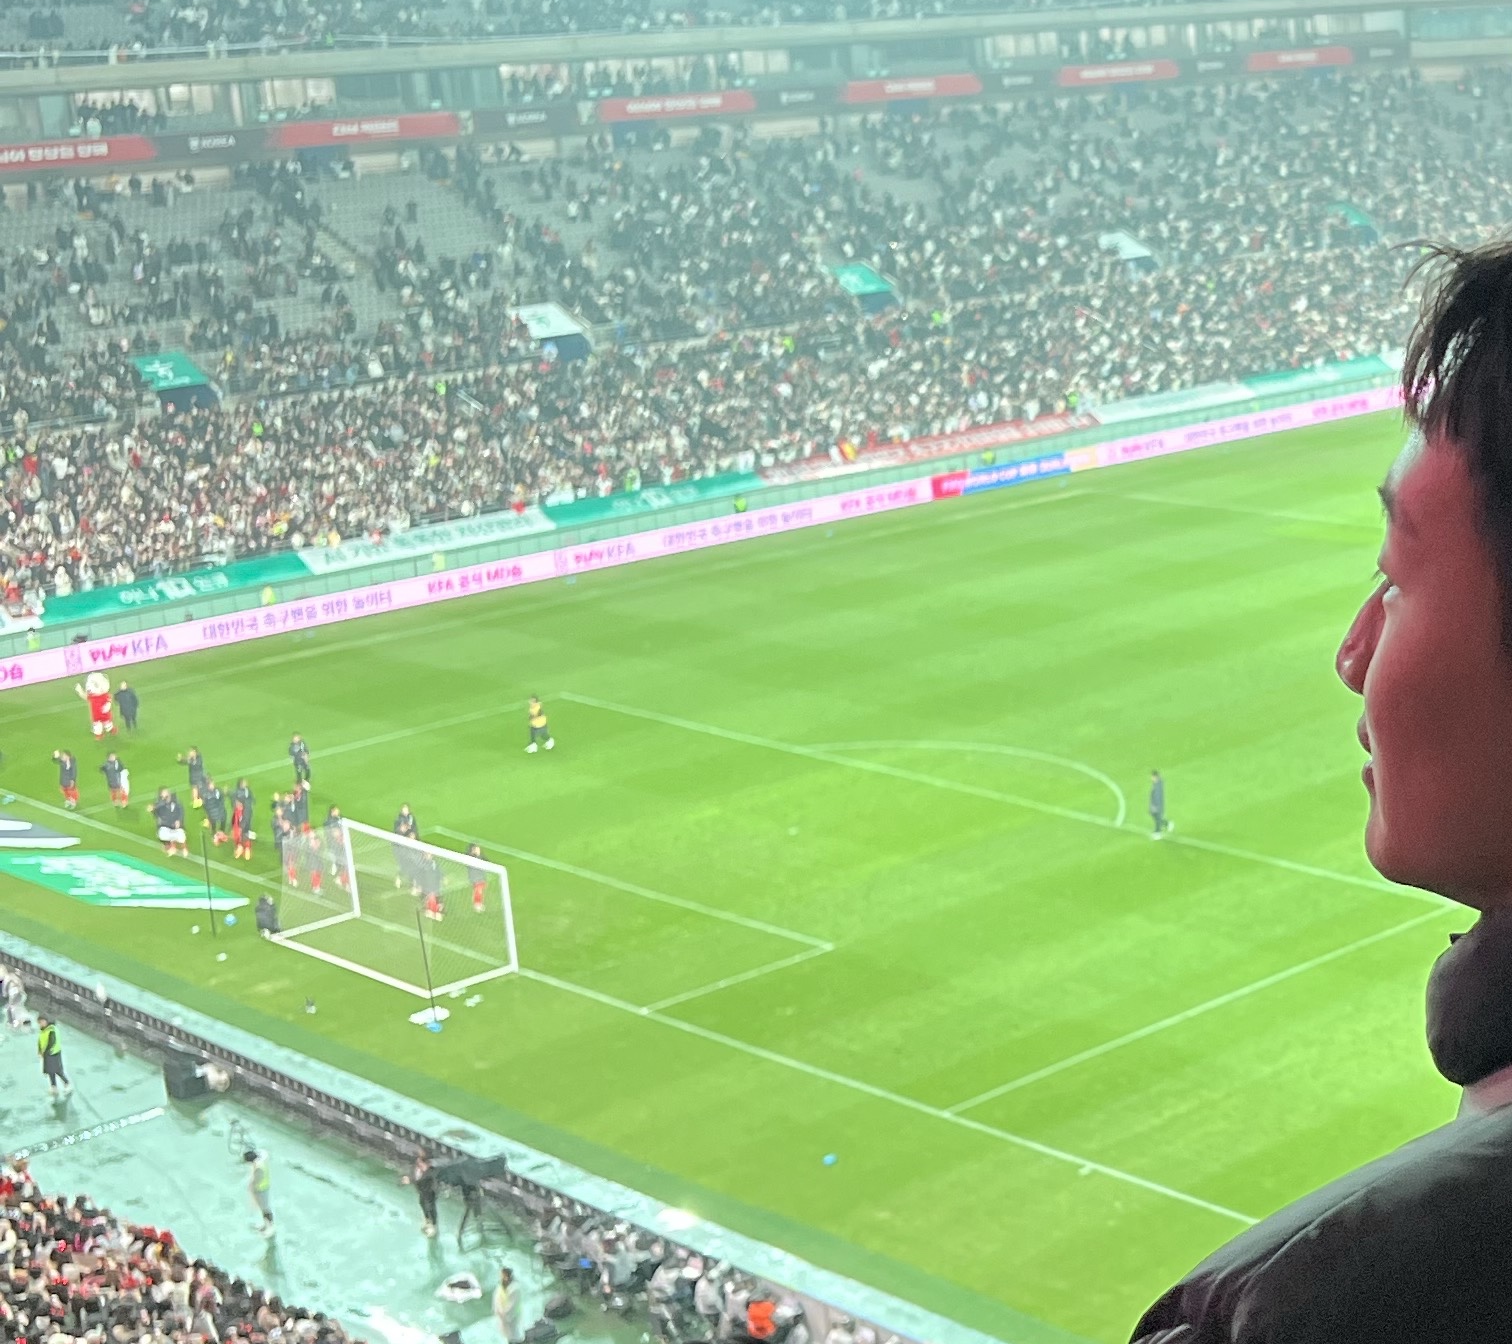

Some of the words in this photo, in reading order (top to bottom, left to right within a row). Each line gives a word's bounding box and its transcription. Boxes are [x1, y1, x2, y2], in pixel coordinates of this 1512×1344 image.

[202, 617, 259, 641] 대한민국
[263, 606, 318, 627] 축구팬을
[322, 599, 348, 617] 위한
[352, 589, 393, 610] 놀이터
[131, 634, 169, 655] KFA
